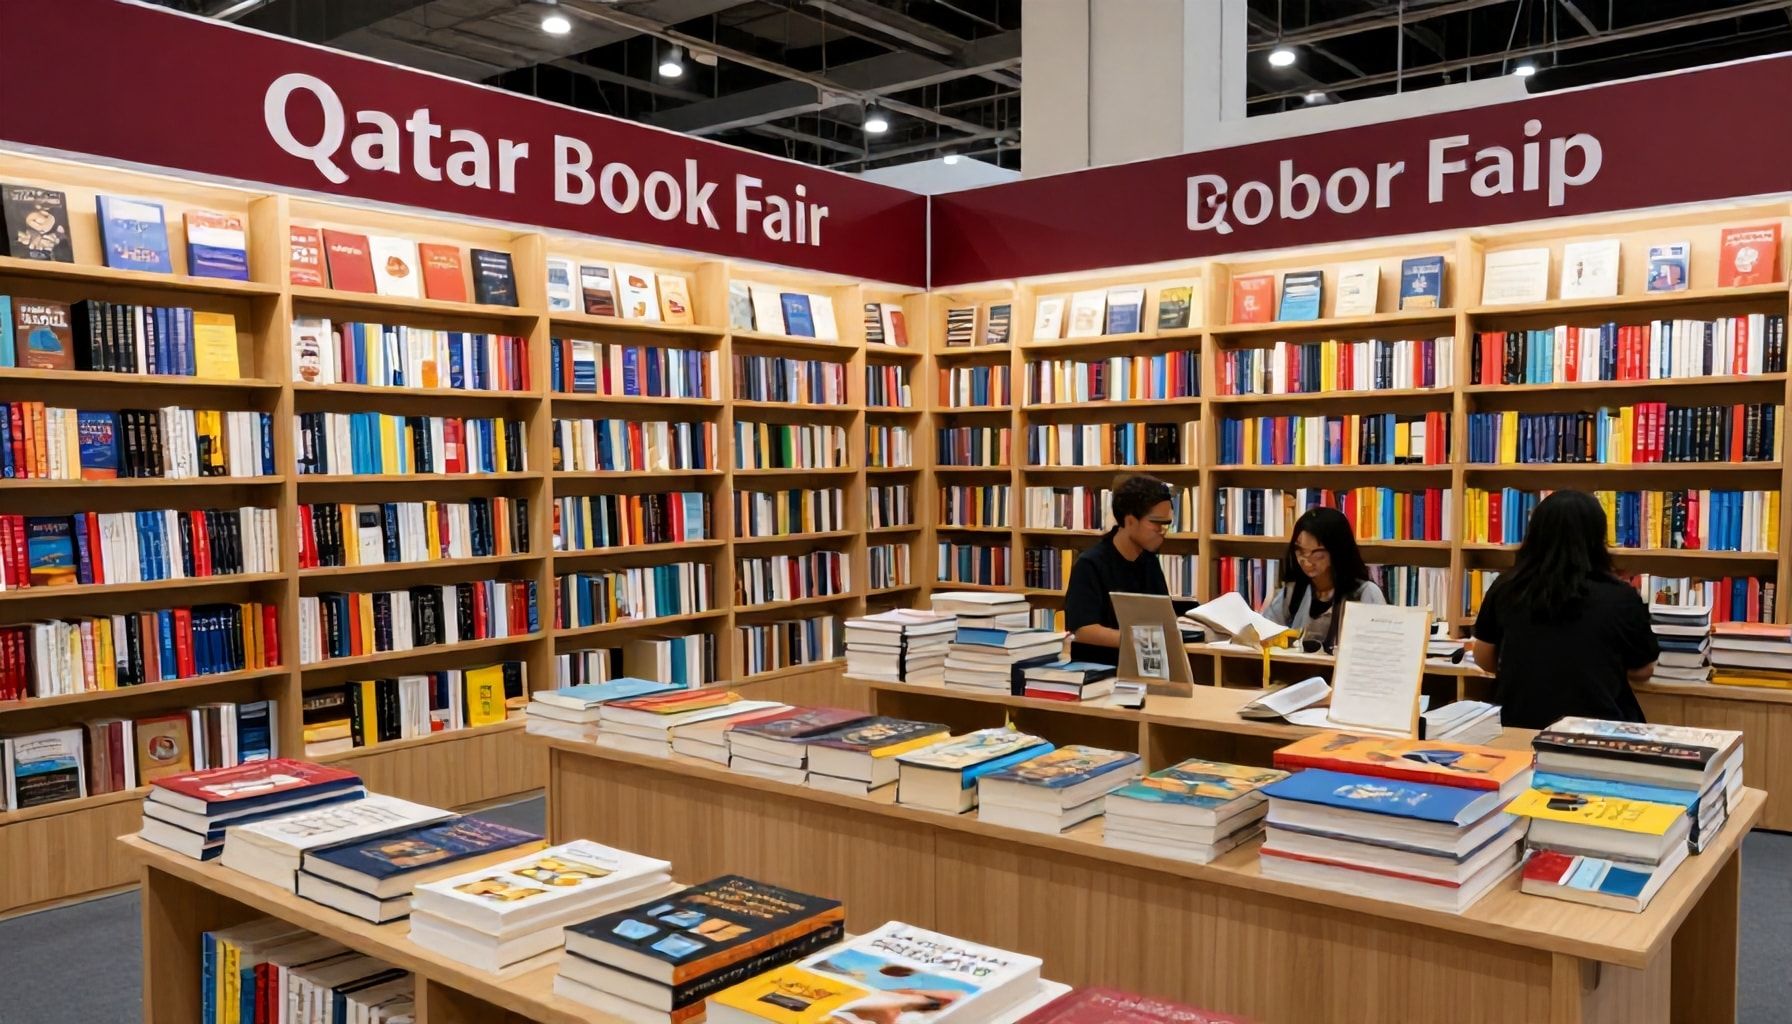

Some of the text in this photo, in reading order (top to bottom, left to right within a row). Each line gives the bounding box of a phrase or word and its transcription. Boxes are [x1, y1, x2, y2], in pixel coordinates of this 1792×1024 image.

[263, 72, 829, 247] Qatar Book Fair
[1428, 119, 1603, 207] Faip
